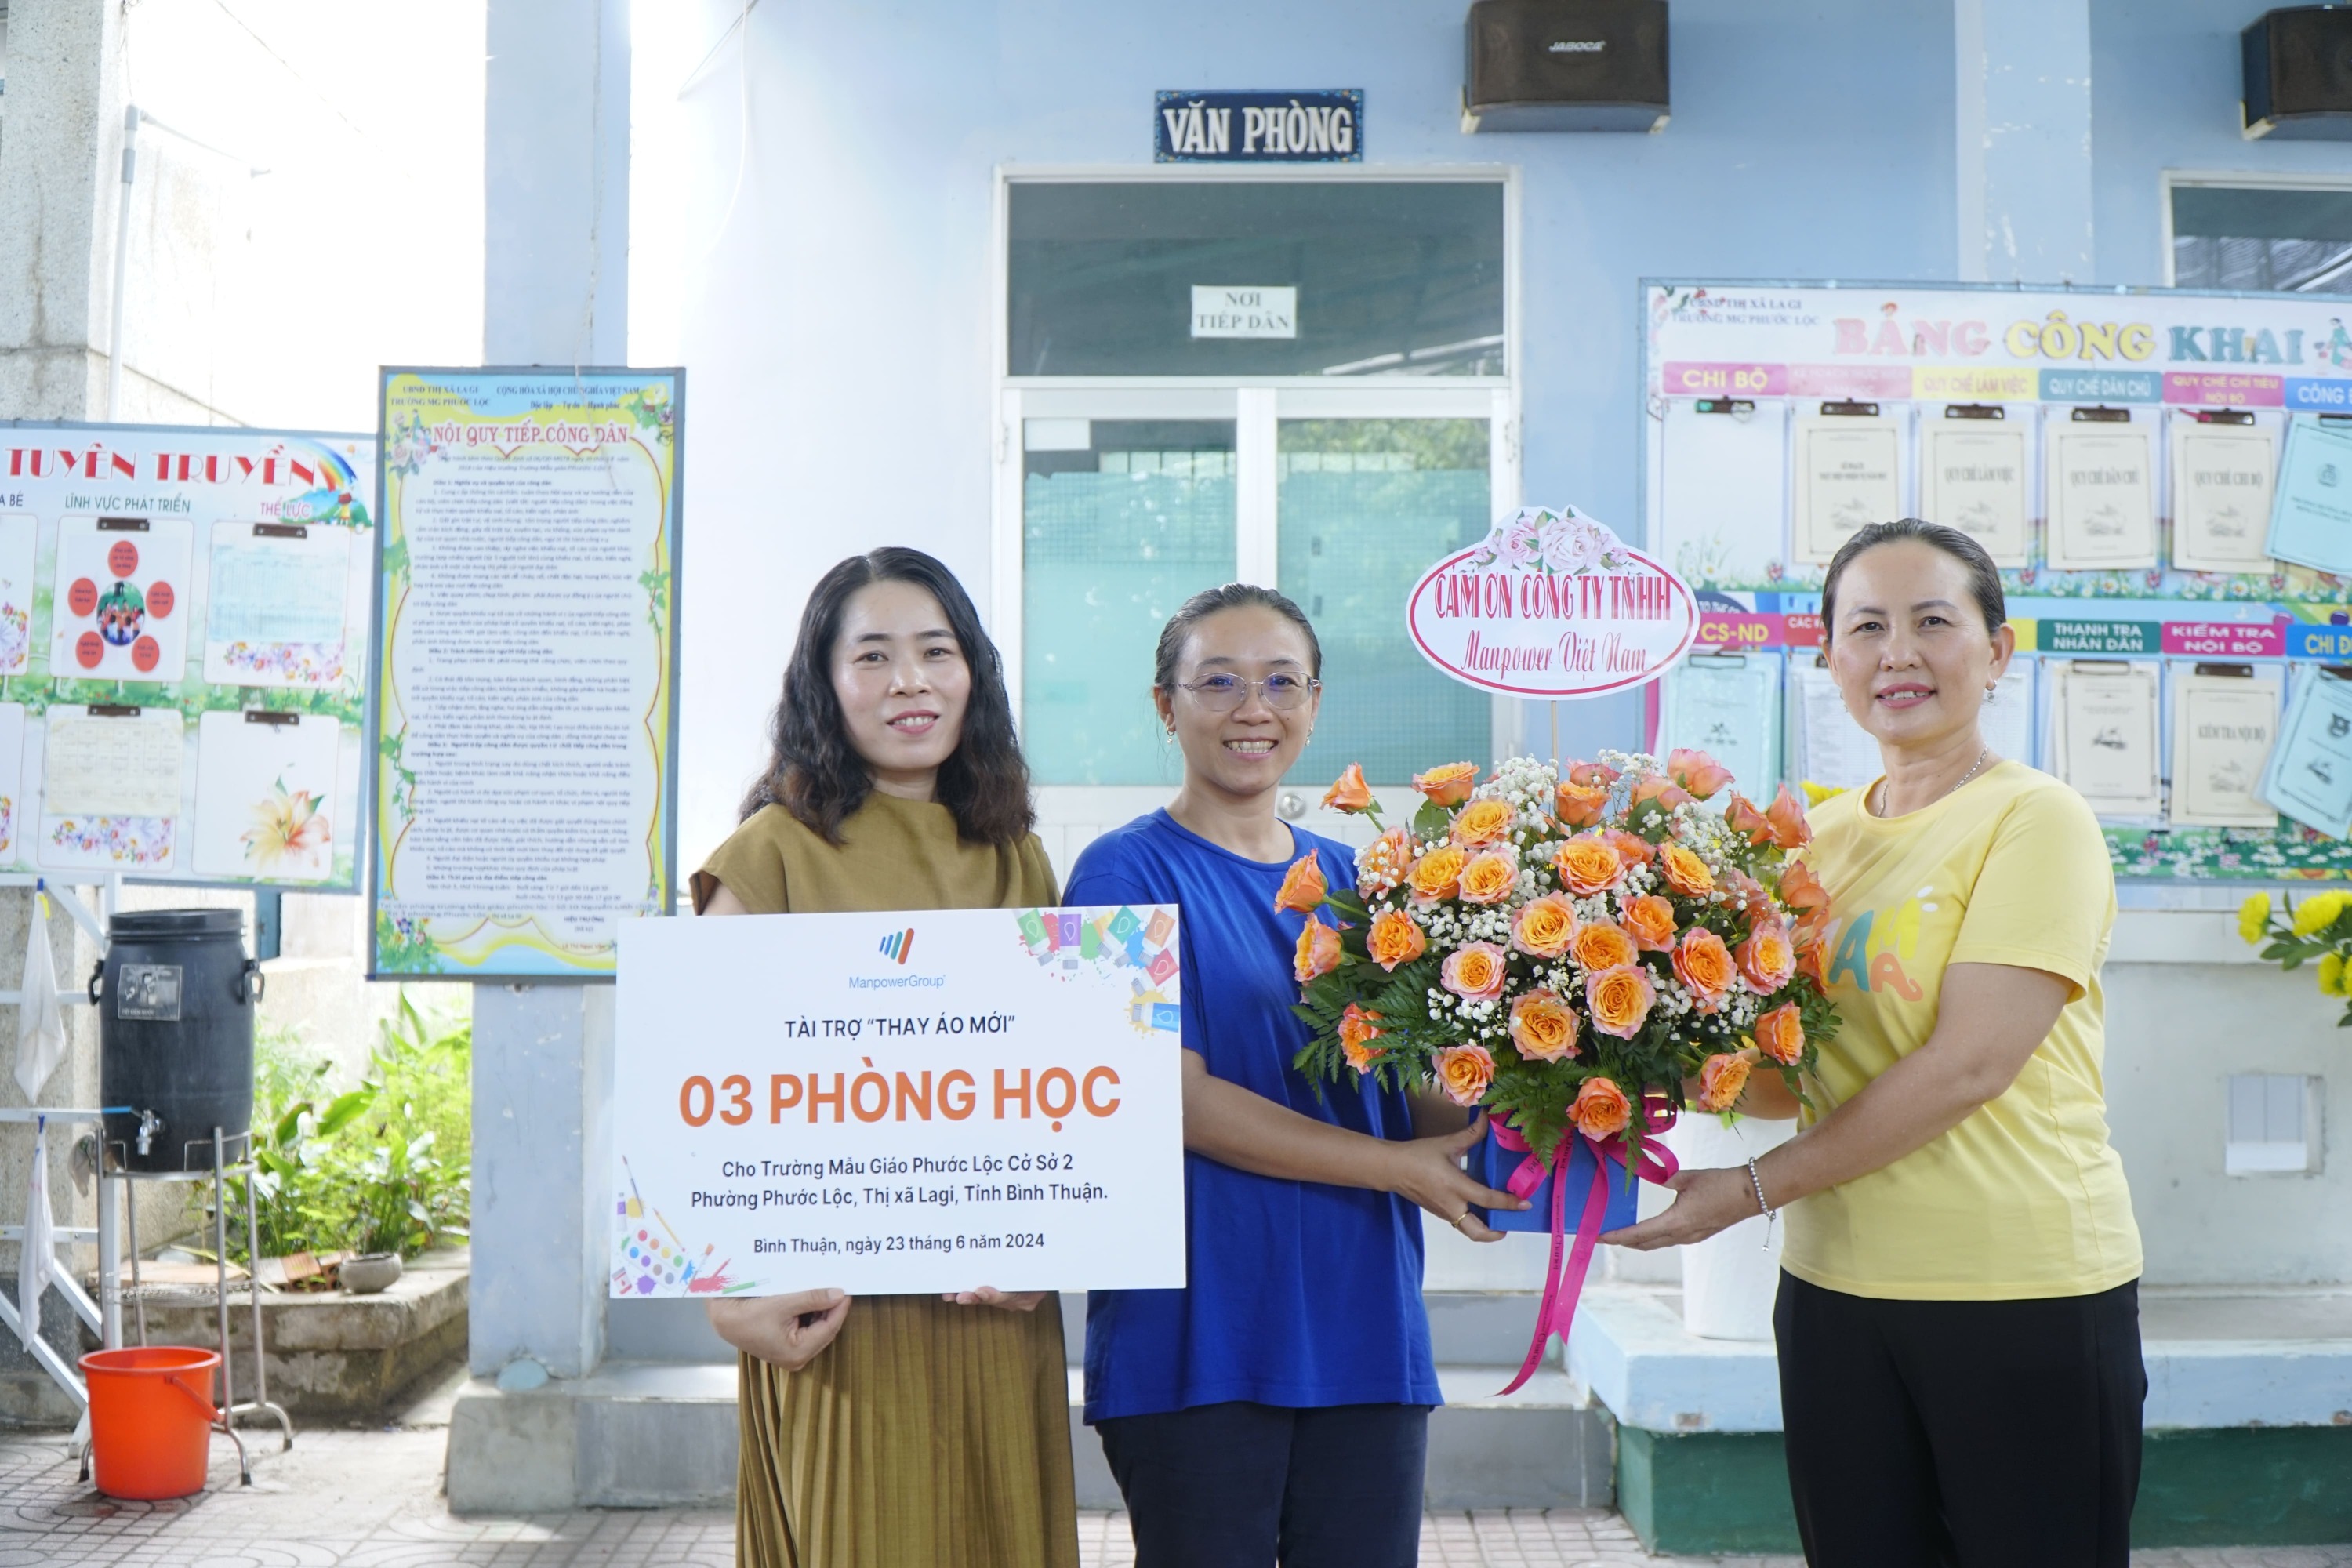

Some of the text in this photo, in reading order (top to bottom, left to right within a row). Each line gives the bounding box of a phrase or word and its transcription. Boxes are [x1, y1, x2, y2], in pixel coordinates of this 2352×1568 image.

[1162, 99, 1353, 154] VĂN PHÒNG
[1834, 302, 2304, 364] BẢNG CÔNG KHAI
[1682, 367, 1769, 391] CHI BỘ
[2049, 374, 2151, 397] QUY CHẾ DÂN CHỦ
[2172, 375, 2199, 387] QUY
[474, 397, 489, 408] LỘC
[2298, 382, 2344, 404] CÔNG
[434, 419, 628, 447] NỘI QUY TIẾP CÔNG DÂN
[5, 442, 315, 486] TUYÊN TRUYỀN
[9, 491, 24, 507] BÉ
[65, 492, 191, 513] LĨNH VỰC PHÁT TRIỂN
[260, 496, 310, 519] THỂ LỰC
[1434, 564, 1671, 620] CẢM ƠN CÔNG TY TNHH
[1700, 622, 1769, 642] CS-ND
[2053, 622, 2143, 637] THANH TRA
[2171, 621, 2276, 639] KIỂM TRA
[2053, 634, 2143, 651] NHÂN DÂN
[2183, 639, 2263, 654] NỘI BỘ
[2305, 633, 2334, 655] CHI
[1460, 630, 1647, 681] Manpower Việt Nam
[848, 975, 945, 991] ManpowerGroup
[784, 1011, 1015, 1041] TÀI TRỢ “THAY ÁO MỚI”
[679, 1056, 1121, 1132] 03 PHÒNG HỌC
[722, 1152, 1073, 1180] Cho Trường Mẫu Giáo Phước Lộc Cở Sở 2
[691, 1181, 1108, 1210] Phường Phước Lộc, Thị xã Lagi, Tỉnh Bình Thuận.
[754, 1232, 1045, 1255] Bình Thuận, ngày 23 tháng 6 năm 2024
